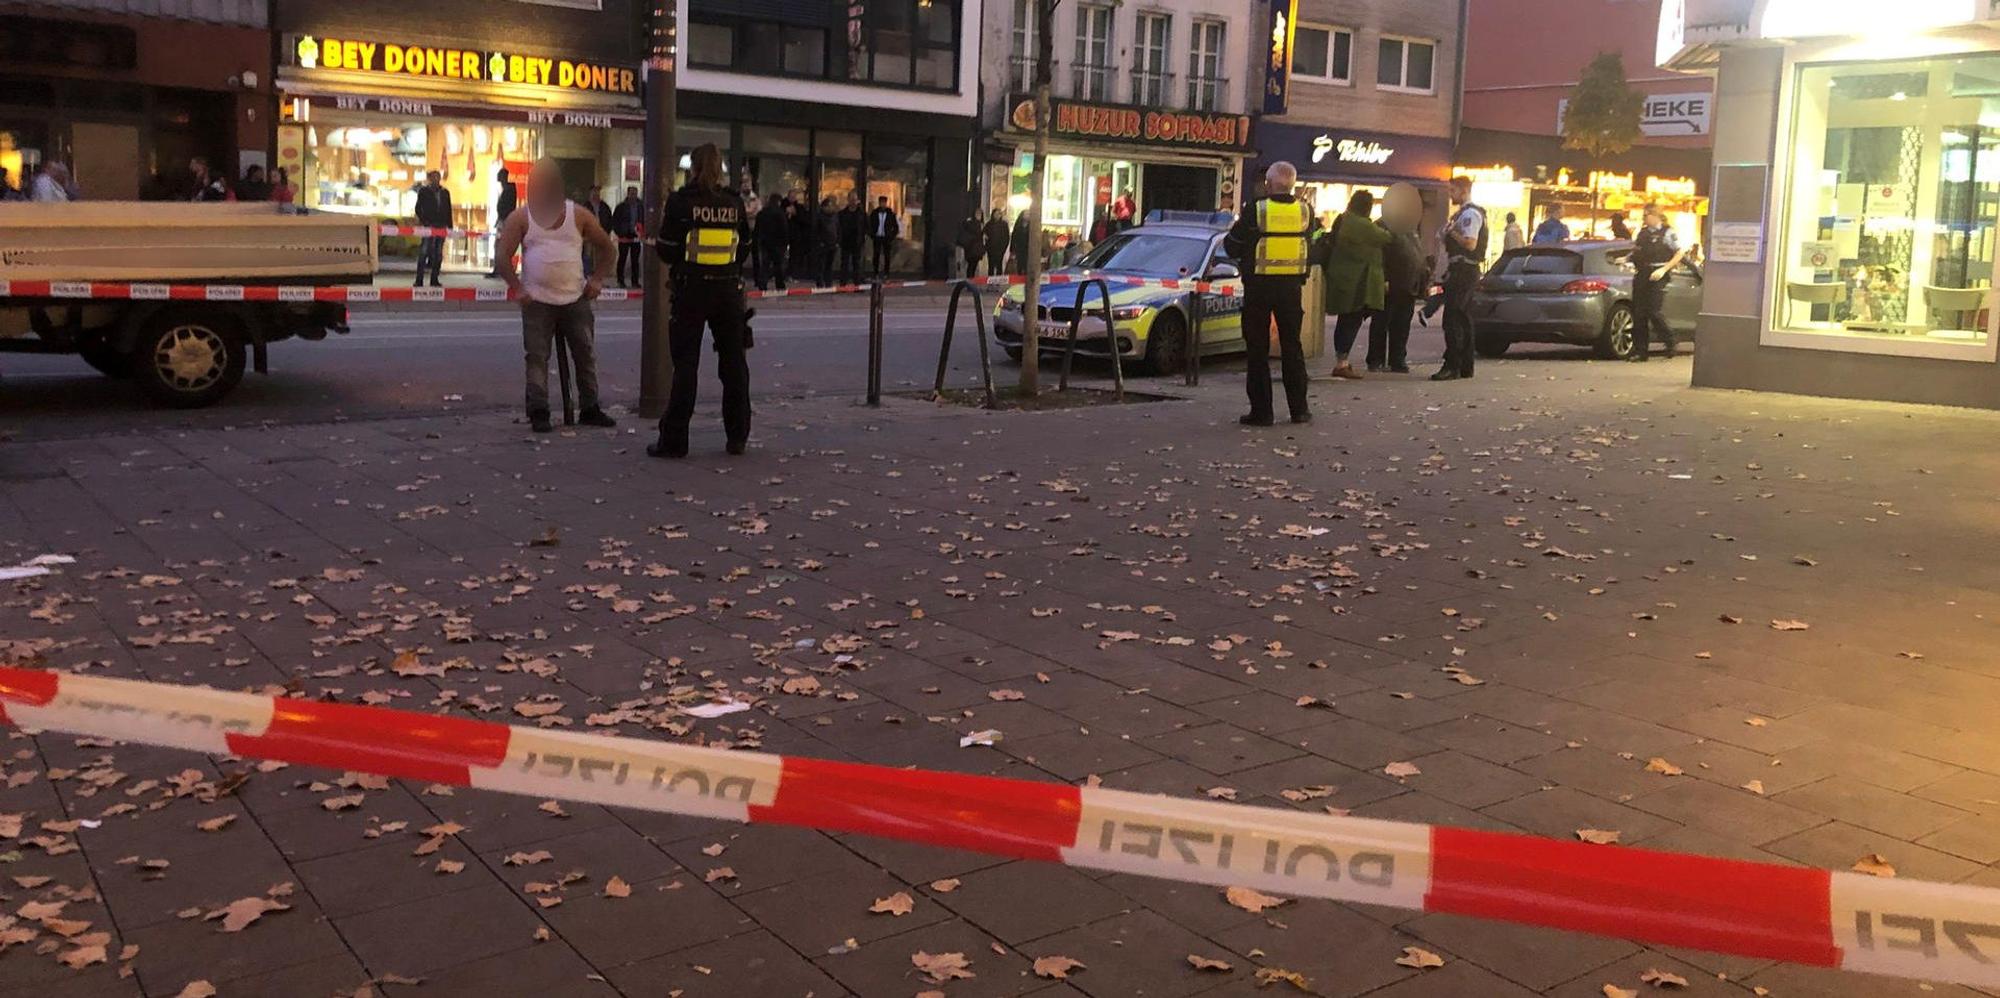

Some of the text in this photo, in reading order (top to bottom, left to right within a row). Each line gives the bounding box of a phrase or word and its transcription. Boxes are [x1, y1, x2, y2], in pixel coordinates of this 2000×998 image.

[323, 38, 376, 70] BEY
[510, 55, 553, 85] BEY
[336, 96, 368, 112] BEY
[528, 111, 556, 124] BEY
[1056, 103, 1141, 138] HUZUR
[1337, 139, 1394, 164] Tchibo
[693, 206, 739, 223] POLIZEI
